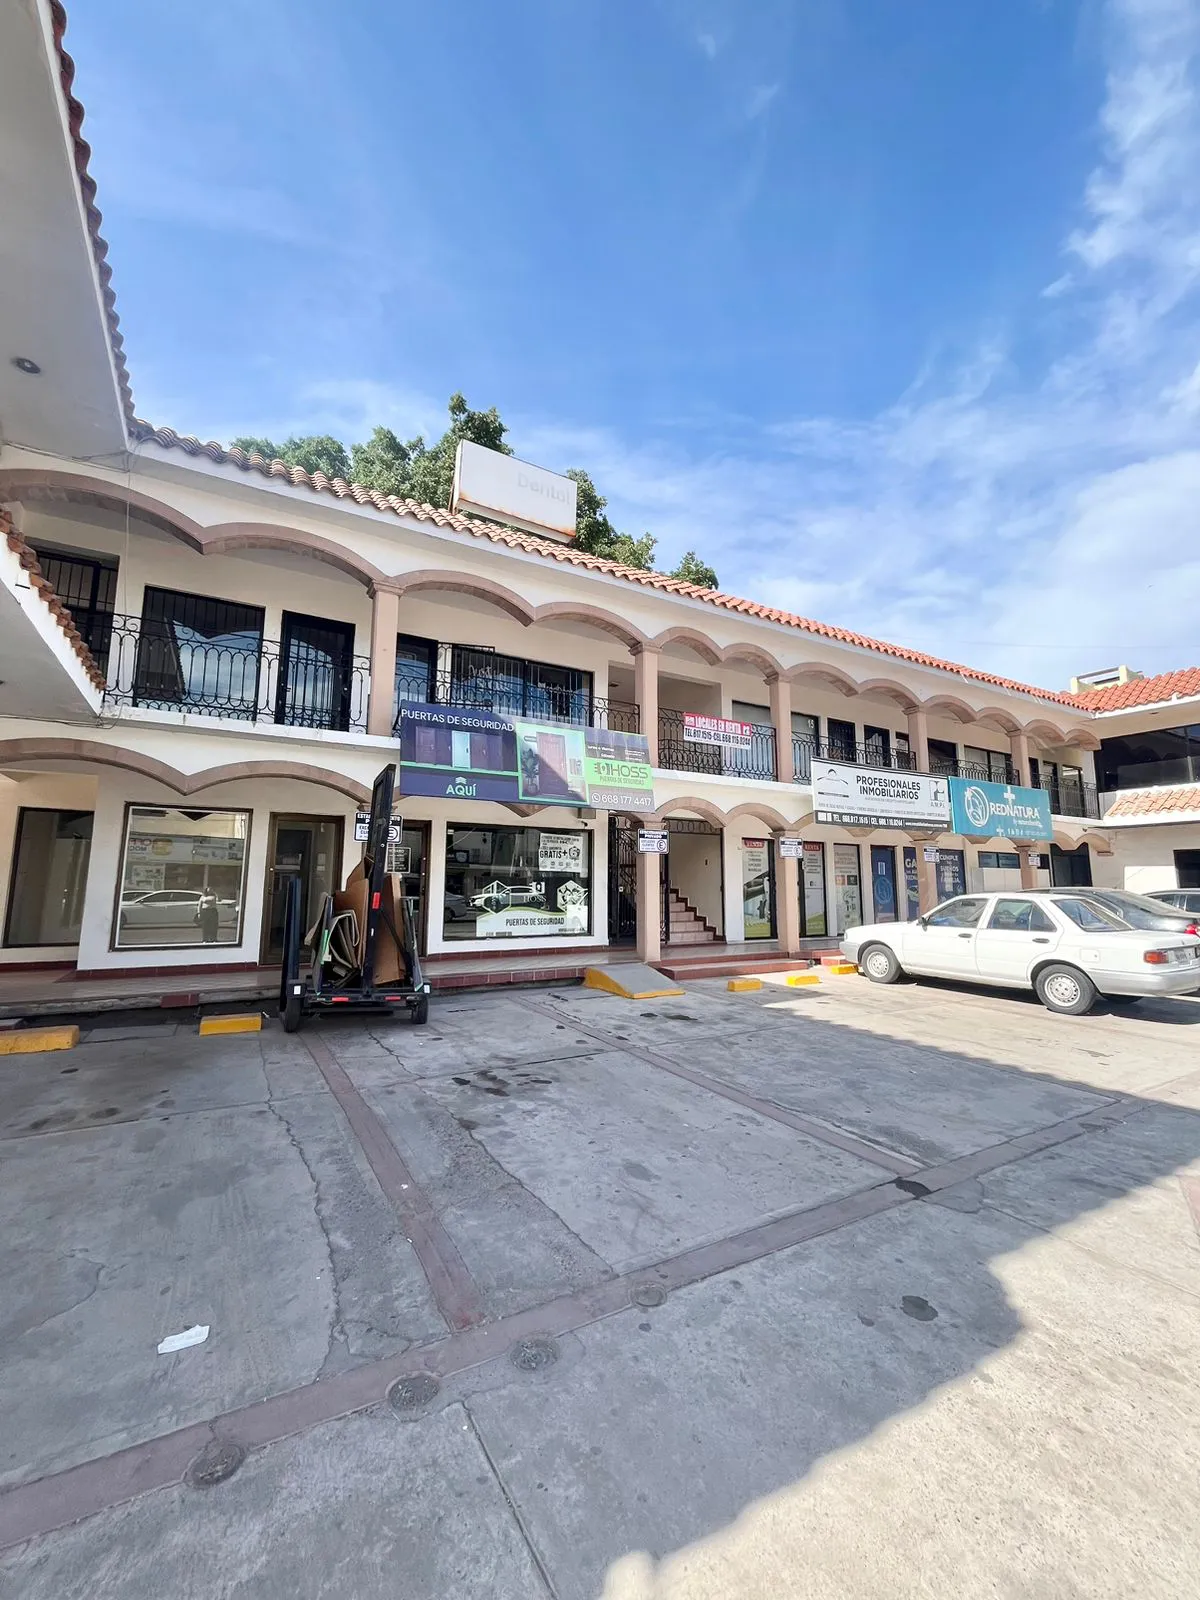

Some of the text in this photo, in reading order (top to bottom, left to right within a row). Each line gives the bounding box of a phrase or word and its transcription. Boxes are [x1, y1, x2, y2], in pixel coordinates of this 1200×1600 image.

[518, 472, 571, 504] Dental
[401, 708, 515, 732] PUERTAS DE SEGURIDAD
[808, 719, 815, 729] 15
[610, 763, 649, 779] HOSS
[856, 775, 921, 791] PROFESIONALES
[446, 784, 477, 796] AQUÍ
[859, 785, 919, 800] INMOBILIARIOS
[601, 794, 652, 806] 668 177 4417
[989, 802, 1041, 820] REDNATURA
[540, 850, 562, 859] GRATIS
[523, 895, 547, 903] HOSS
[505, 918, 529, 926] PUERTAS
[538, 917, 565, 925] SEGURIDAD
